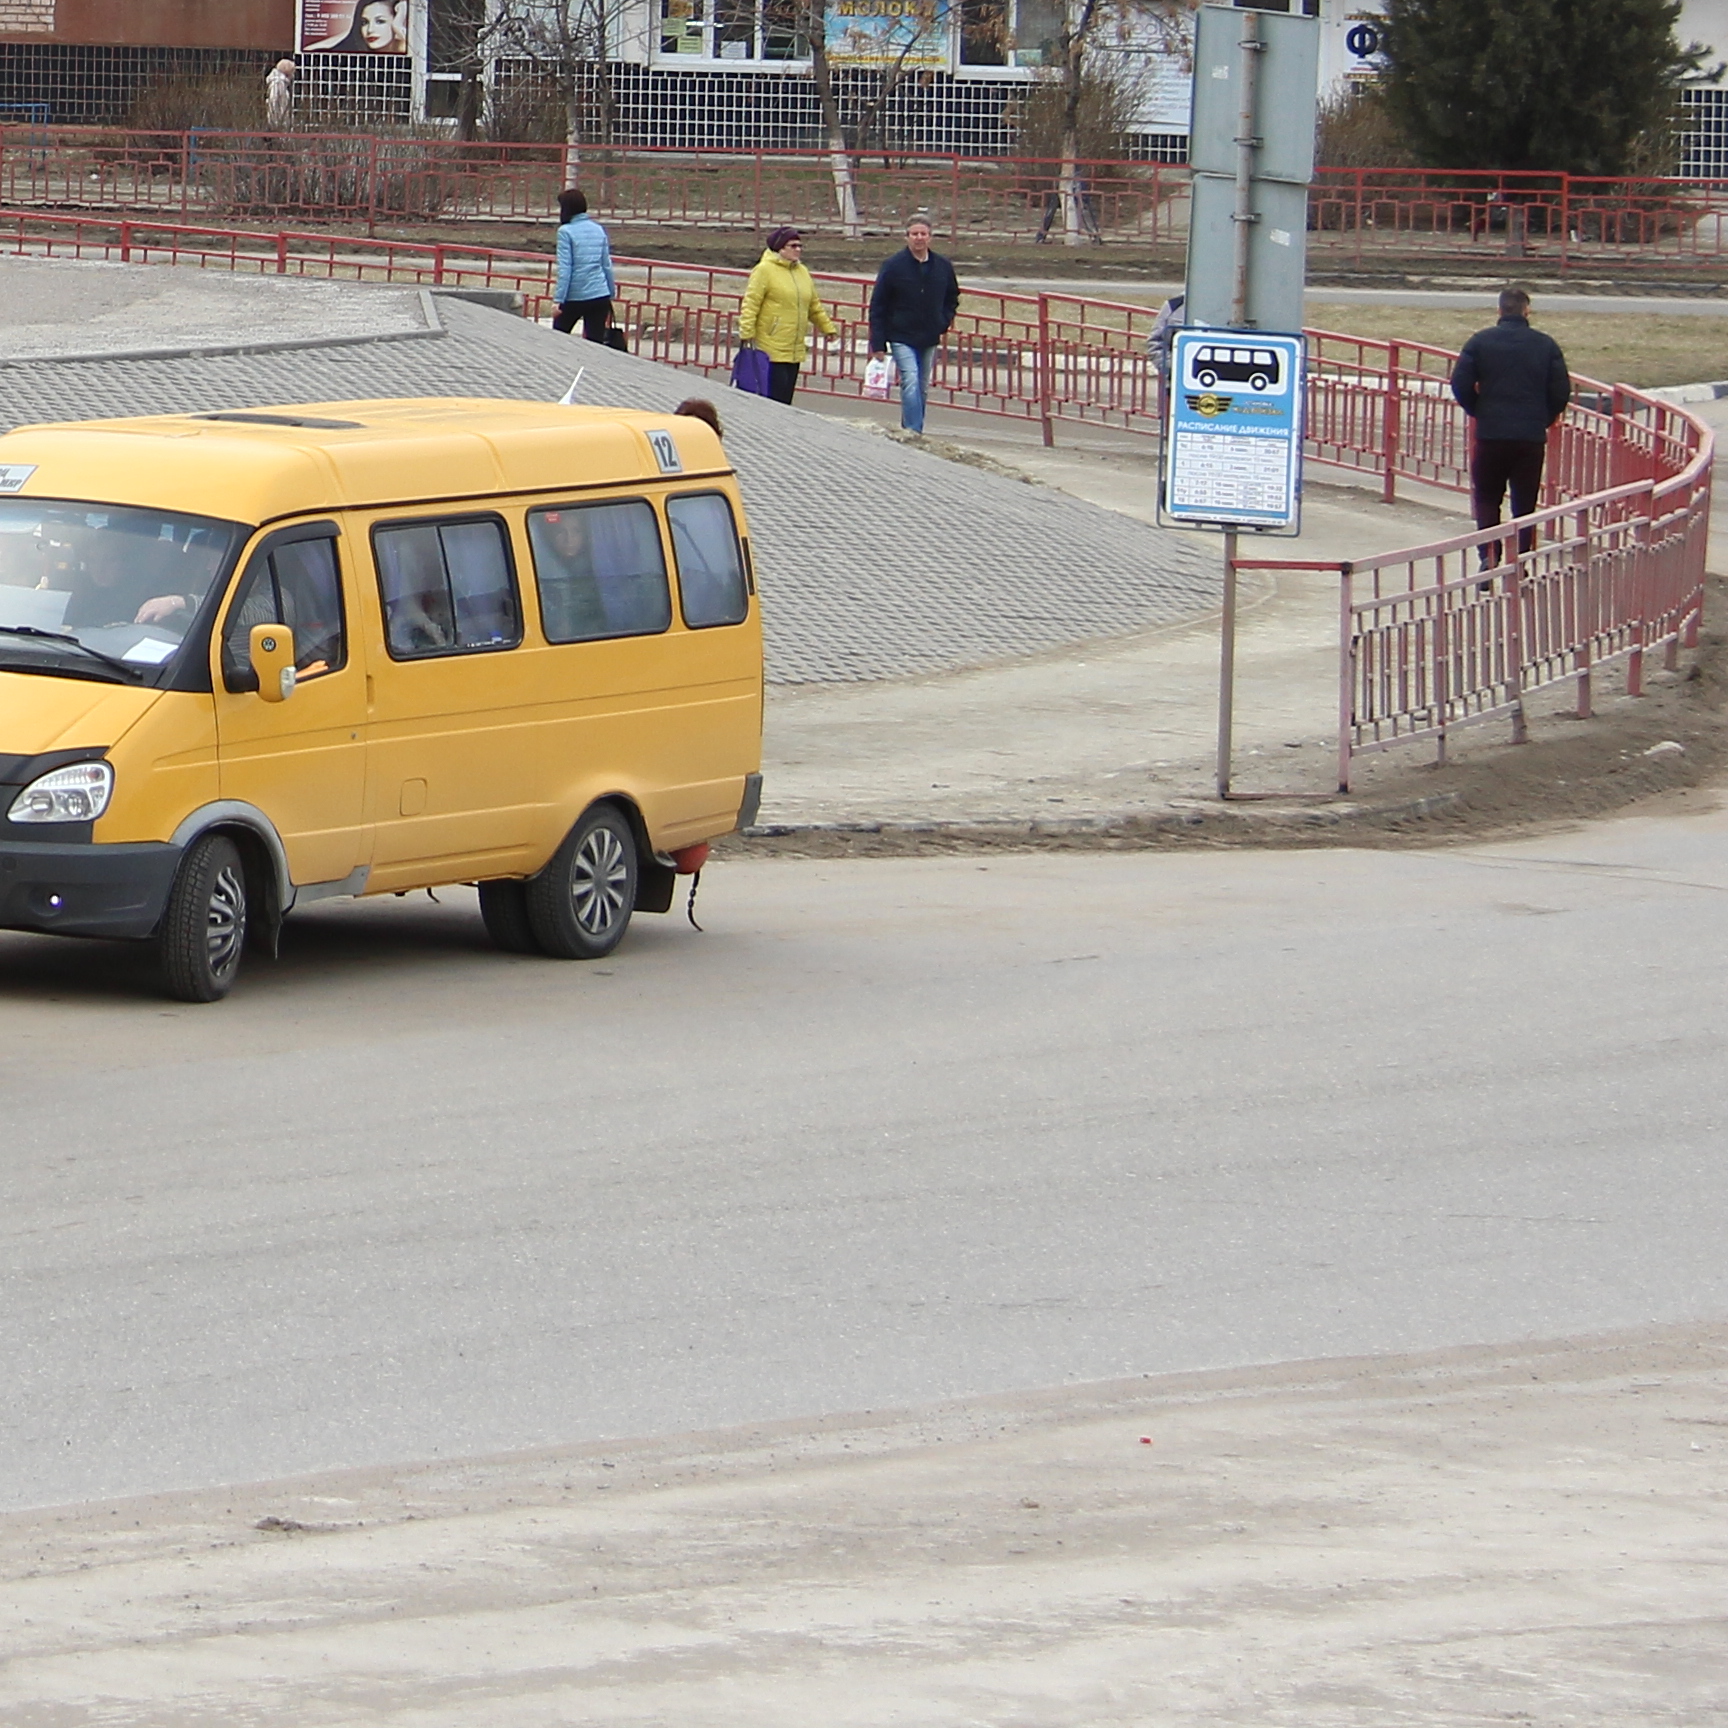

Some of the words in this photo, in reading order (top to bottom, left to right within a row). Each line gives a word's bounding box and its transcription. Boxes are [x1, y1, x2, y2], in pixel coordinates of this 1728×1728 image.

[838, 0, 934, 16] МОЛОК
[1177, 420, 1237, 433] РАСПИСАНИЕ
[1238, 424, 1289, 436] ДВИЖЕНИЯ
[654, 436, 678, 467] 12
